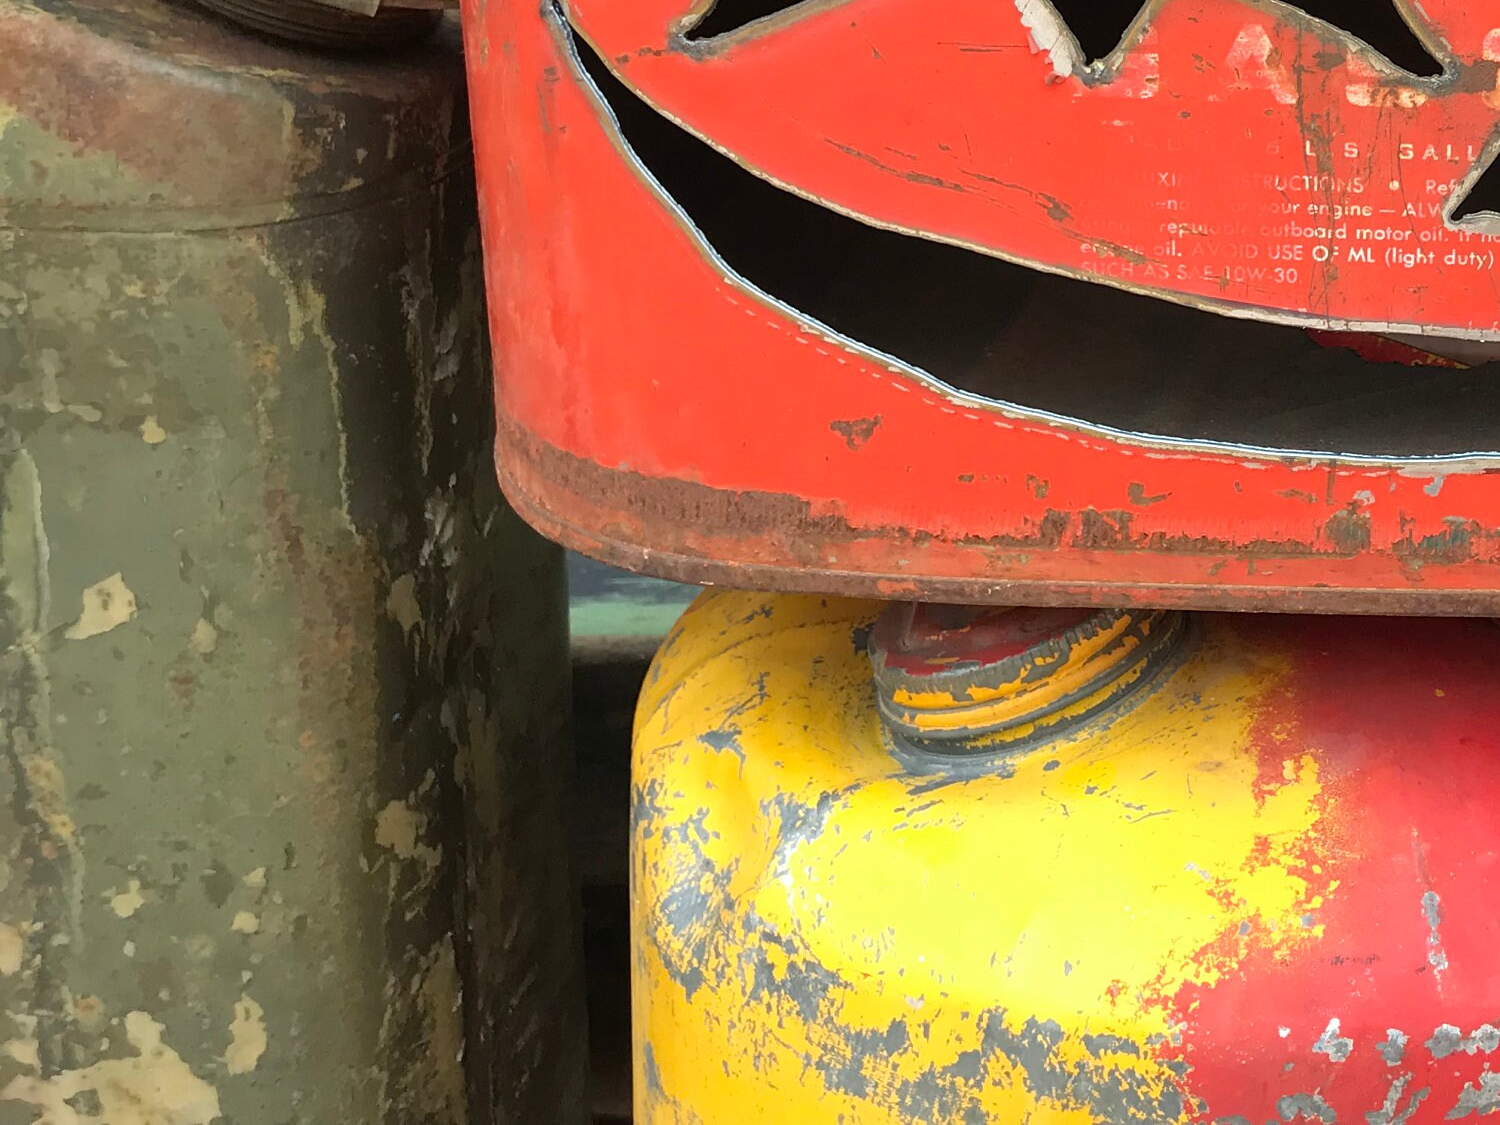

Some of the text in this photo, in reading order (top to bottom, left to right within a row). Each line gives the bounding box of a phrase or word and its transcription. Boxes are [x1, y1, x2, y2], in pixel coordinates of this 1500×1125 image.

[1306, 201, 1373, 220] engine
[1259, 220, 1348, 240] outboard
[1355, 227, 1414, 243] motor
[1416, 226, 1449, 242] oil.
[1268, 244, 1304, 261] USE
[1347, 246, 1376, 265] ML
[1383, 246, 1436, 269] (light
[1443, 248, 1495, 271] duty)
